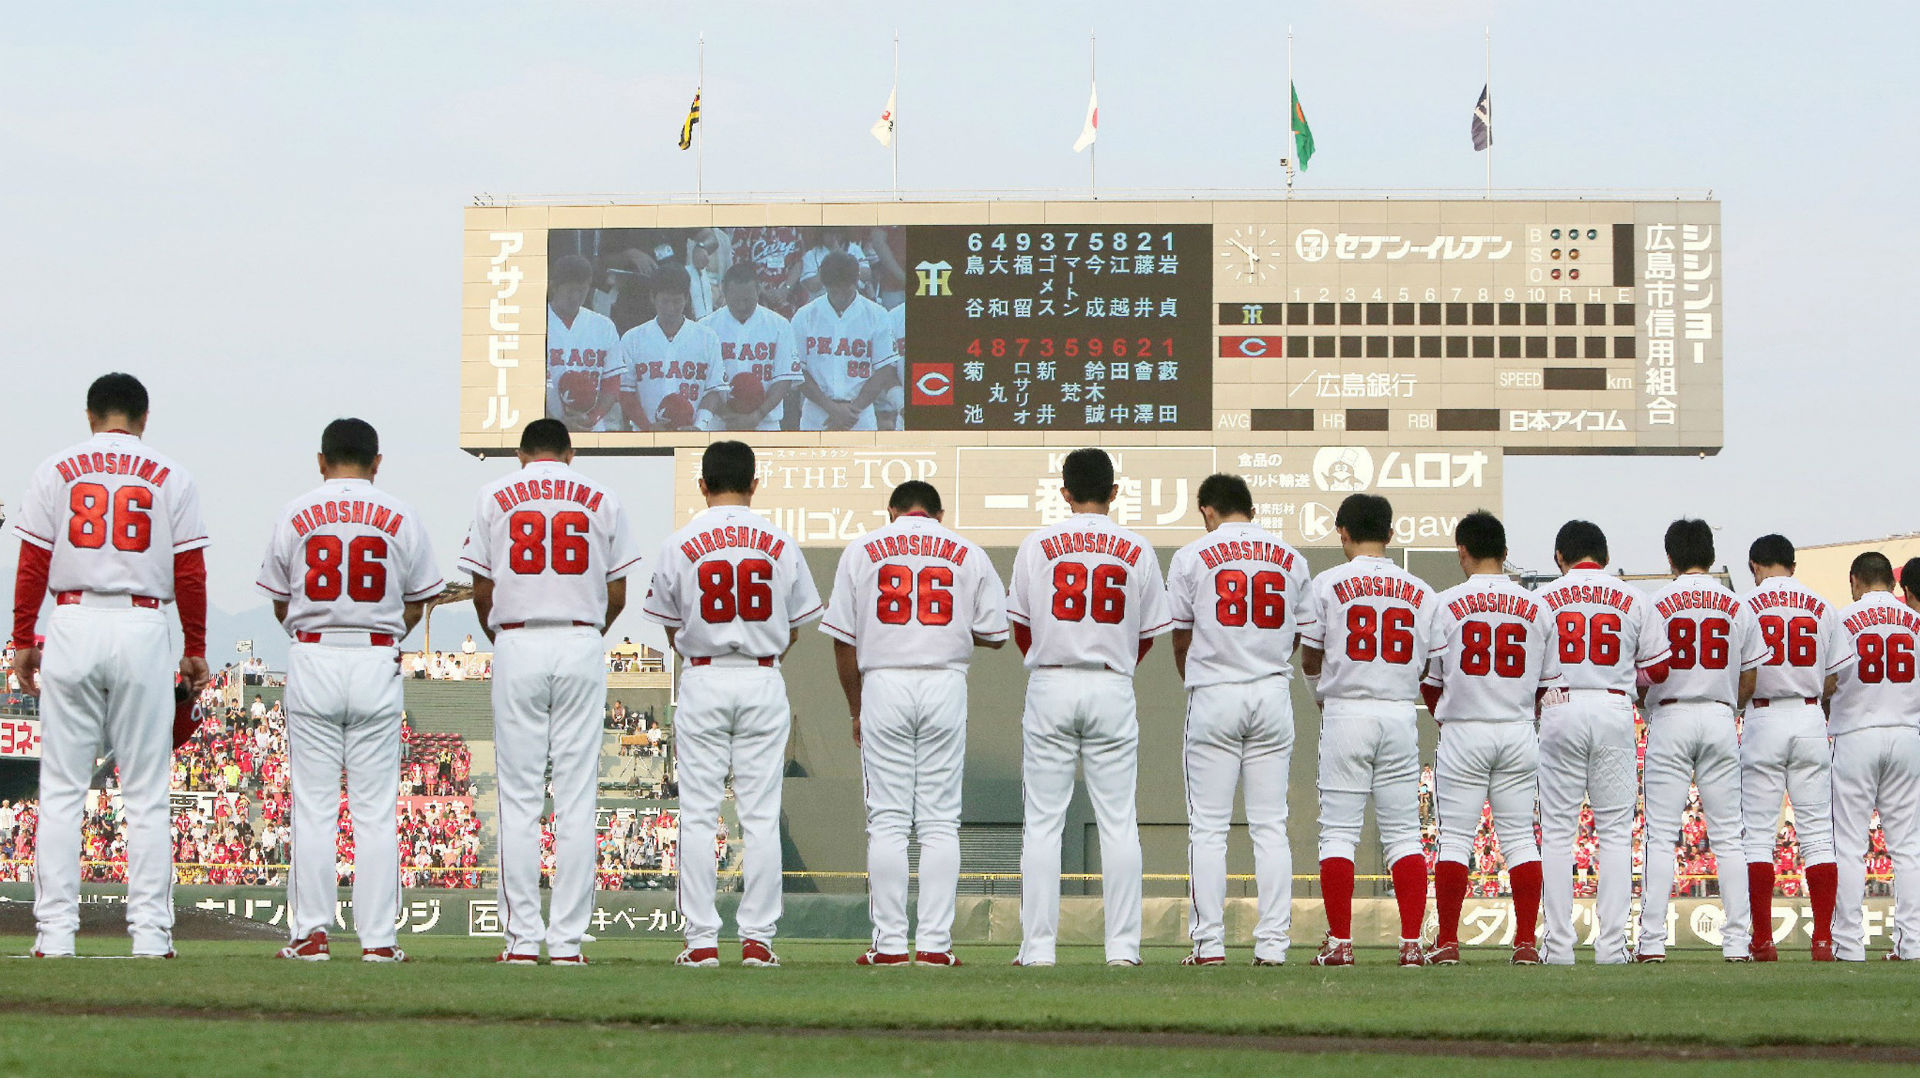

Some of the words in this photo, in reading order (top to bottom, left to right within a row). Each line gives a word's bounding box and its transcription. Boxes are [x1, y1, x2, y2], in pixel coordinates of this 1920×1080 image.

[1530, 229, 1542, 241] B
[1531, 248, 1542, 262] S
[1293, 288, 1301, 302] 1
[1319, 288, 1329, 302] 2
[1346, 288, 1356, 302] 3
[1372, 288, 1382, 302] 4
[1399, 288, 1409, 302] 5
[1425, 288, 1435, 302] 6
[1452, 288, 1462, 302] 7
[1478, 288, 1488, 302] 8
[1504, 288, 1515, 302] 9
[1528, 288, 1545, 302] 10
[1560, 288, 1572, 302] R
[1589, 288, 1600, 302] H
[1619, 288, 1629, 302] E
[1682, 224, 1713, 364] シシンヨー
[482, 231, 525, 430] アサヒビール
[1644, 223, 1678, 425] 広島市信用組合
[988, 382, 1008, 404] 丸
[1500, 373, 1541, 387] SPEED
[1607, 374, 1632, 389] km
[1218, 413, 1250, 428] AVG
[1322, 413, 1345, 428] HR
[1408, 413, 1434, 428] RBI
[1509, 409, 1627, 431] 日本アイコム
[56, 452, 171, 488] HIROSHIMA
[778, 466, 849, 489] THE
[854, 459, 938, 489] TOP
[1237, 453, 1282, 467] 食品の
[1375, 450, 1488, 488] ムロオ
[493, 479, 604, 513] HIROSHIMA
[68, 482, 153, 553] 86
[291, 500, 404, 538] HIROSHIMA
[509, 510, 590, 575] 86
[680, 525, 786, 564] HIROSHIMA
[864, 534, 969, 567] HIROSHIMA
[1040, 532, 1142, 568] HIROSHIMA
[1199, 540, 1295, 573] HIROSHIMA
[304, 534, 388, 603] 86
[698, 558, 773, 624] 86
[876, 563, 954, 626] 86
[1051, 561, 1128, 624] 86
[1215, 569, 1286, 629] 86
[1332, 575, 1425, 610] HIROSHIMA
[1447, 592, 1538, 623] HIROSHIMA
[1542, 585, 1633, 614] HIROSHIMA
[1655, 590, 1740, 620] HIROSHIMA
[1345, 604, 1415, 665] 86
[1556, 611, 1621, 666] 86
[1842, 606, 1920, 636] HIROSHIMA
[1460, 620, 1527, 678] 86
[1668, 617, 1730, 670] 86
[1758, 615, 1818, 667] 86
[1856, 633, 1915, 684] 86
